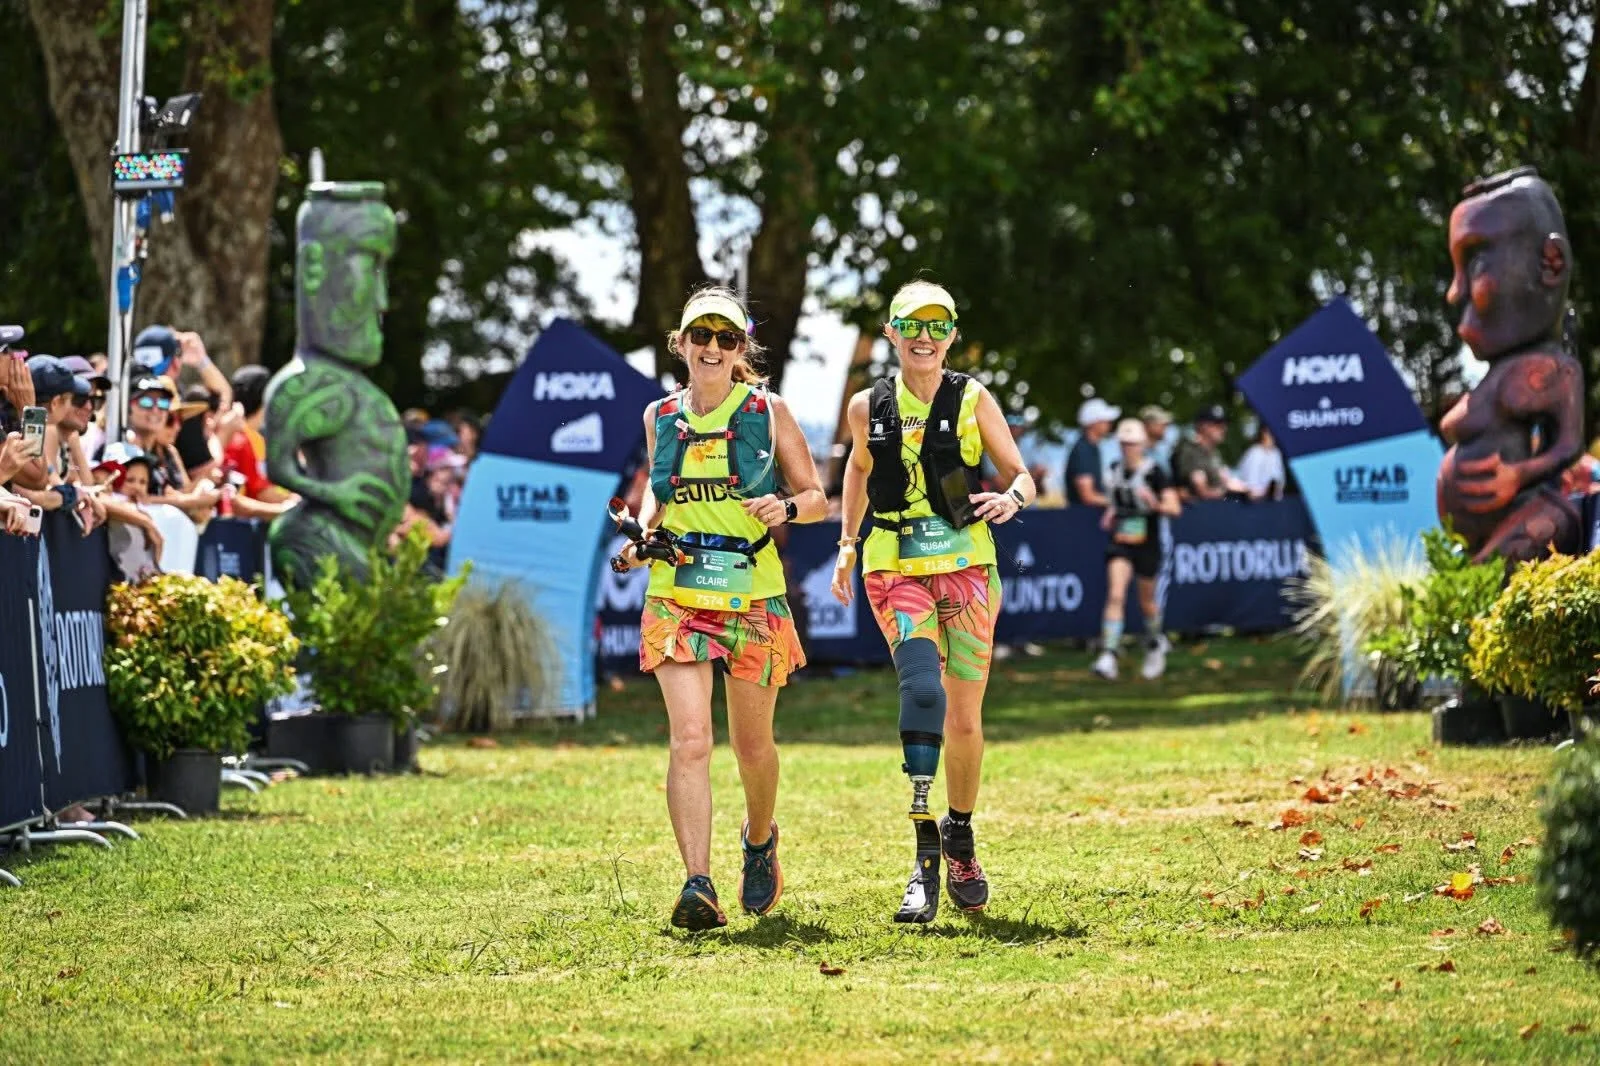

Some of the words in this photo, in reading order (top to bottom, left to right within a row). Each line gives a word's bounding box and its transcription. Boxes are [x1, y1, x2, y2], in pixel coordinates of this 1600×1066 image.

[1282, 354, 1364, 386] HOKA
[534, 372, 616, 401] HOKA
[1288, 407, 1365, 429] SUUNTO
[1336, 465, 1408, 487] UTMB
[497, 485, 570, 506] UTMB
[920, 541, 951, 551] SUSAN
[696, 575, 728, 588] CLAIRE
[1001, 573, 1083, 614] UNTO
